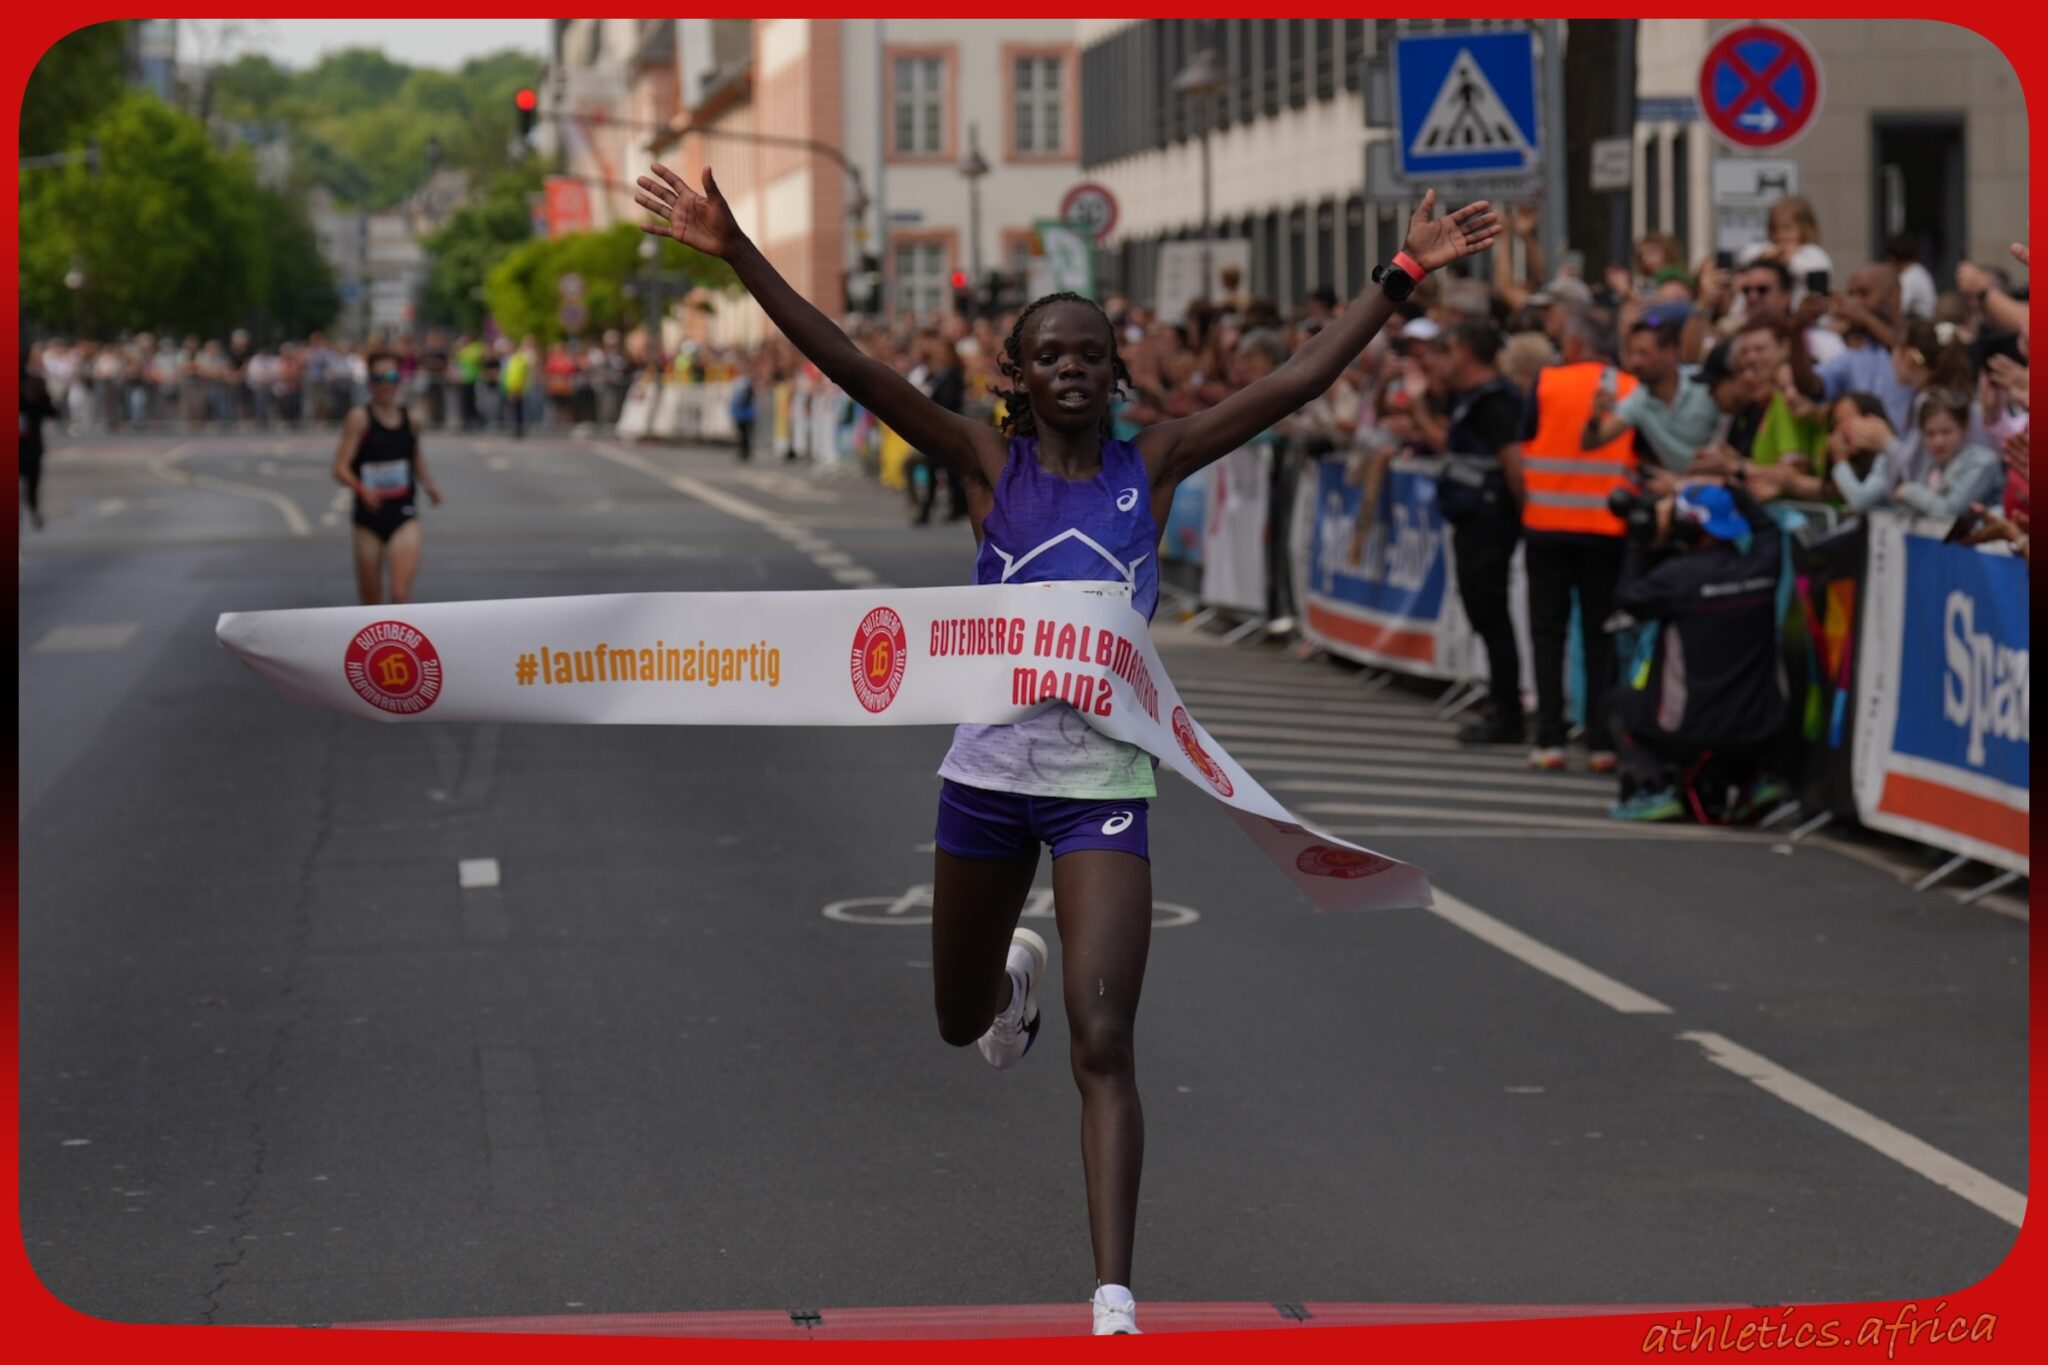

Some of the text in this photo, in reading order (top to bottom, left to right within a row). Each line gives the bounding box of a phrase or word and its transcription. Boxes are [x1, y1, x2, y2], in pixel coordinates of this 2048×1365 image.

[355, 623, 423, 651] GUTENBERG
[862, 609, 902, 637] GUTENBERG
[515, 640, 780, 687] #laufmainzigartig
[929, 617, 1160, 725] GUTENBERG HALBMARATHON
